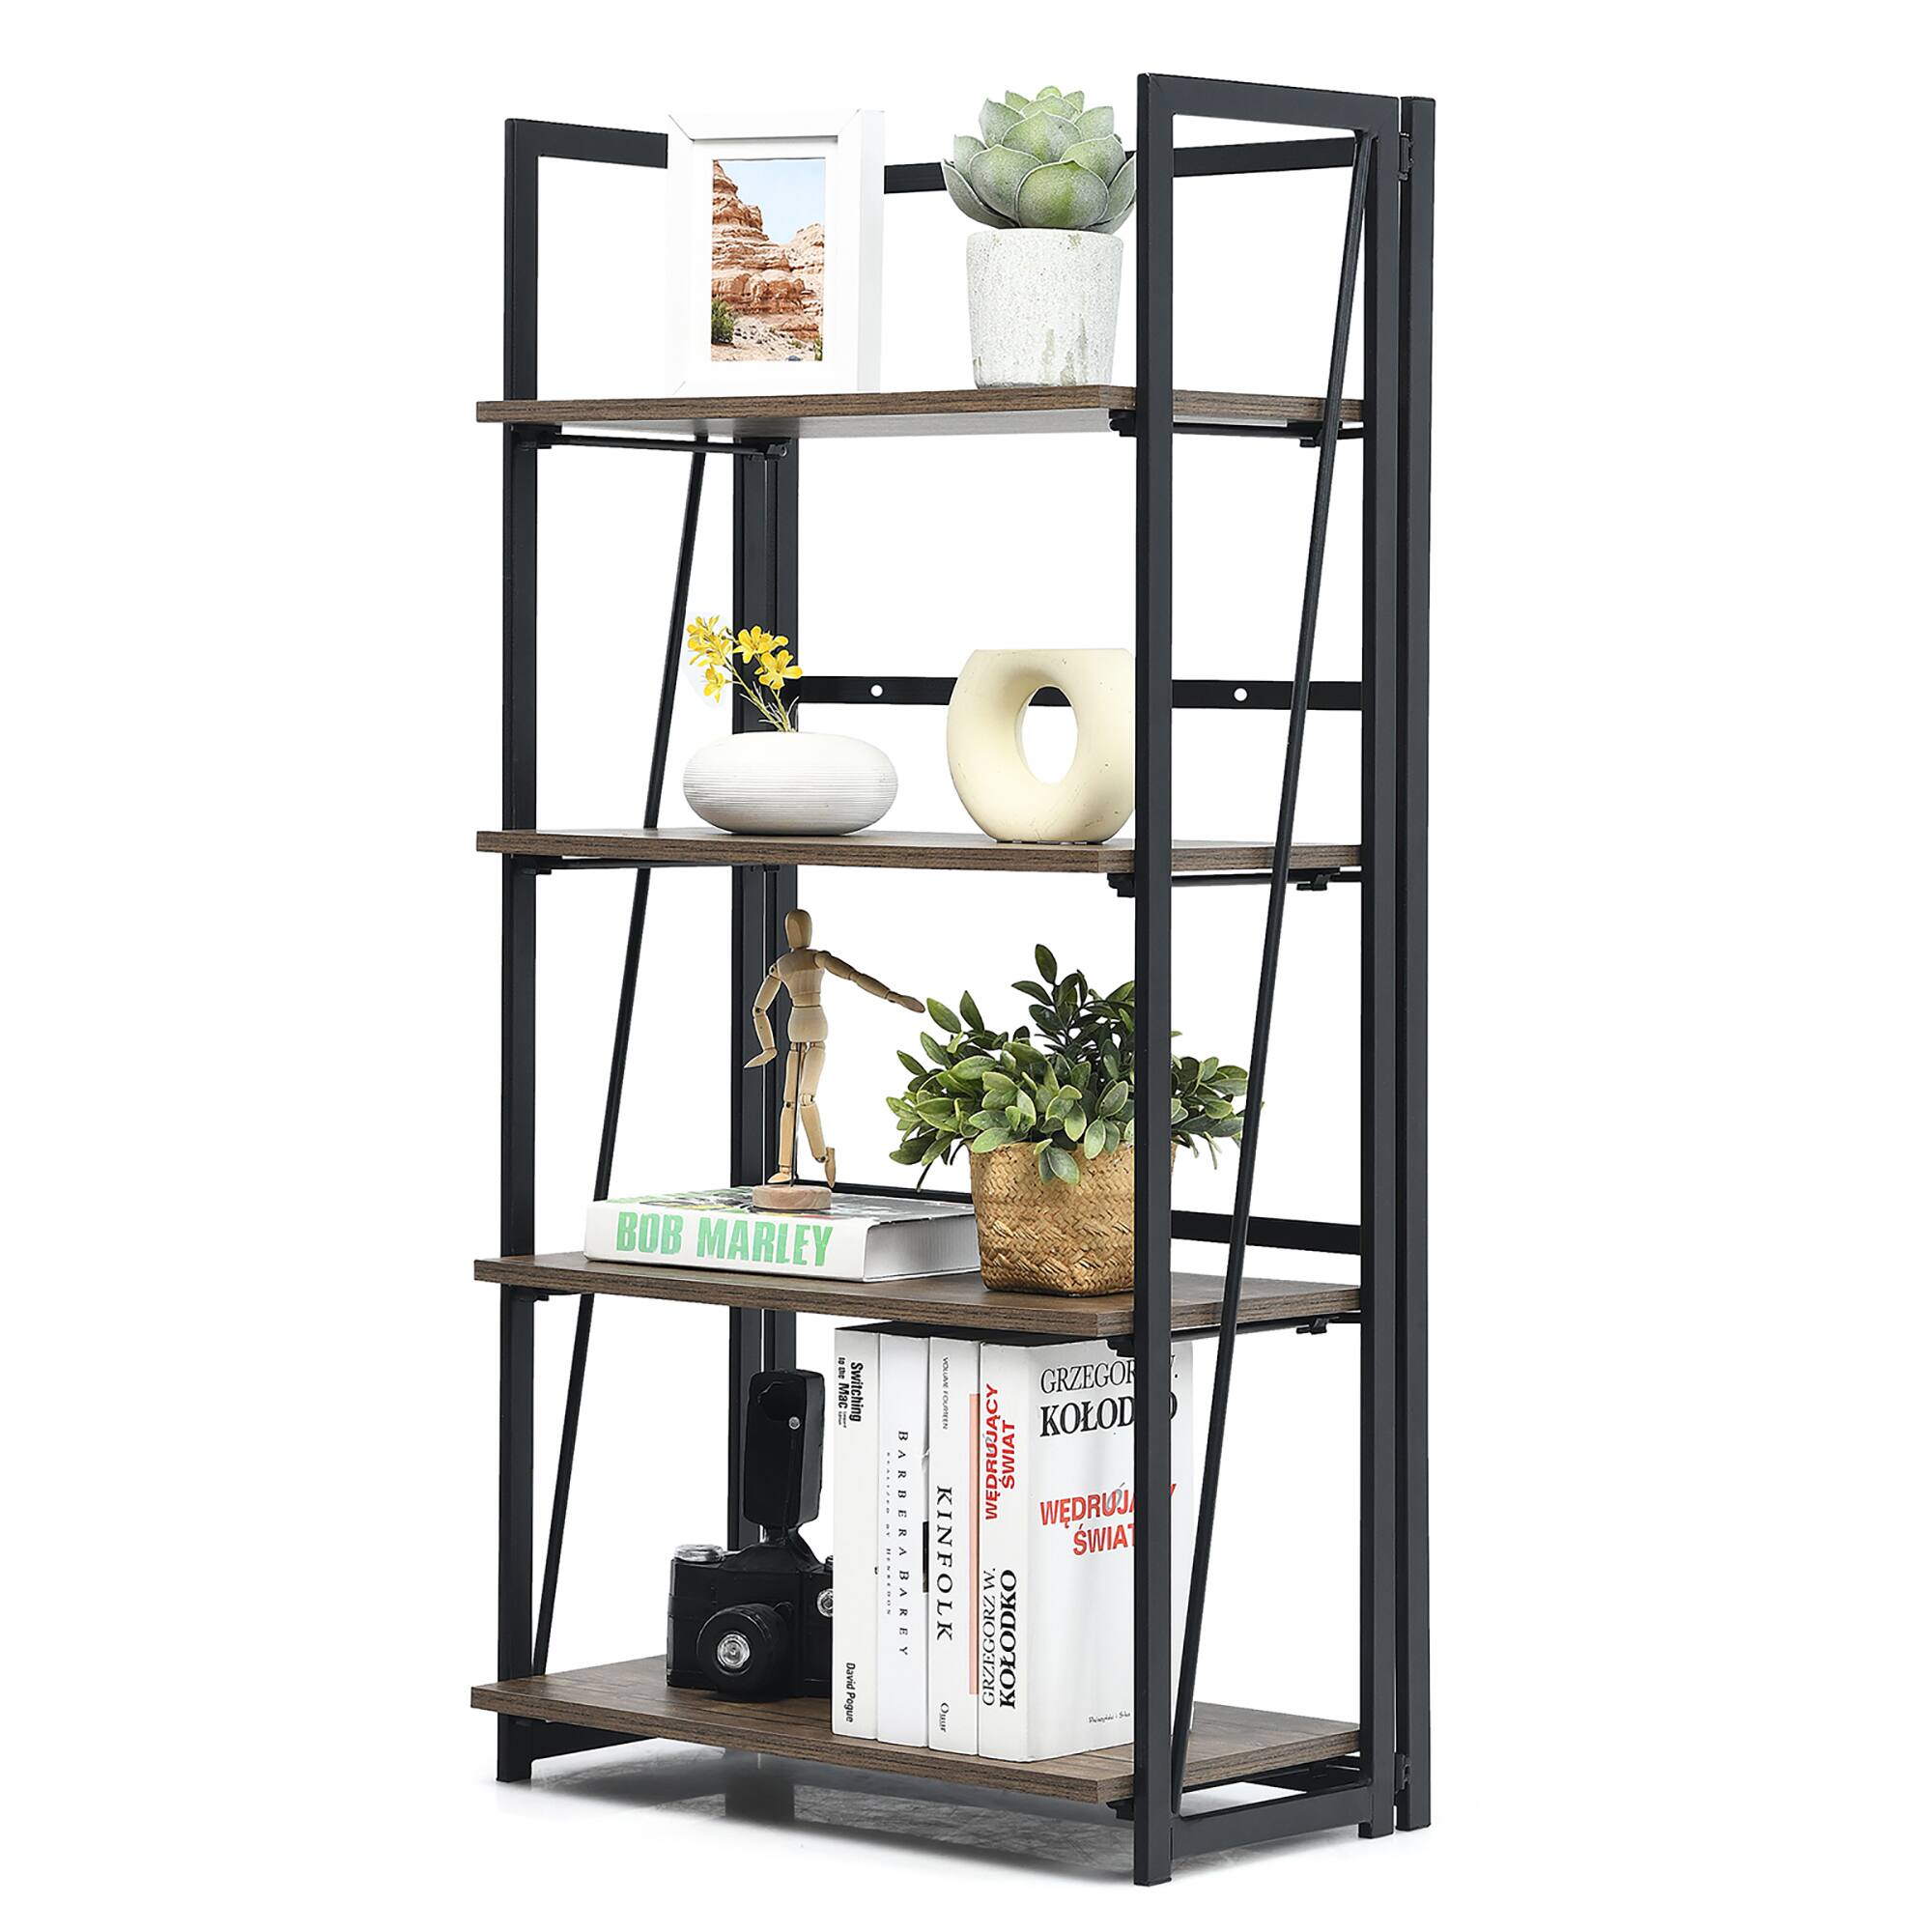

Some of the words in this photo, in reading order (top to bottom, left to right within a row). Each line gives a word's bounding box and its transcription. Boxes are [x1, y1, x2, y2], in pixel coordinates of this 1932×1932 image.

[615, 1210, 684, 1256] BOB
[696, 1216, 834, 1267] MARLEY
[838, 1356, 846, 1366] to
[838, 1366, 846, 1380] the
[942, 1355, 951, 1388] VOLUME
[1040, 1359, 1136, 1394] GRZEGOR
[838, 1381, 850, 1409] Mac
[849, 1361, 865, 1423] Switching
[942, 1390, 951, 1431] FOURTEEN
[984, 1383, 1001, 1520] WĘDRUJĄCY
[998, 1419, 1015, 1490] ŚWIAT
[936, 1485, 953, 1641] KINFOLK
[982, 1567, 996, 1590] W.
[981, 1595, 996, 1706] GRZEGORZ
[999, 1569, 1017, 1709] KOŁODKO
[845, 1662, 857, 1689] David
[843, 1691, 857, 1723] Pogue
